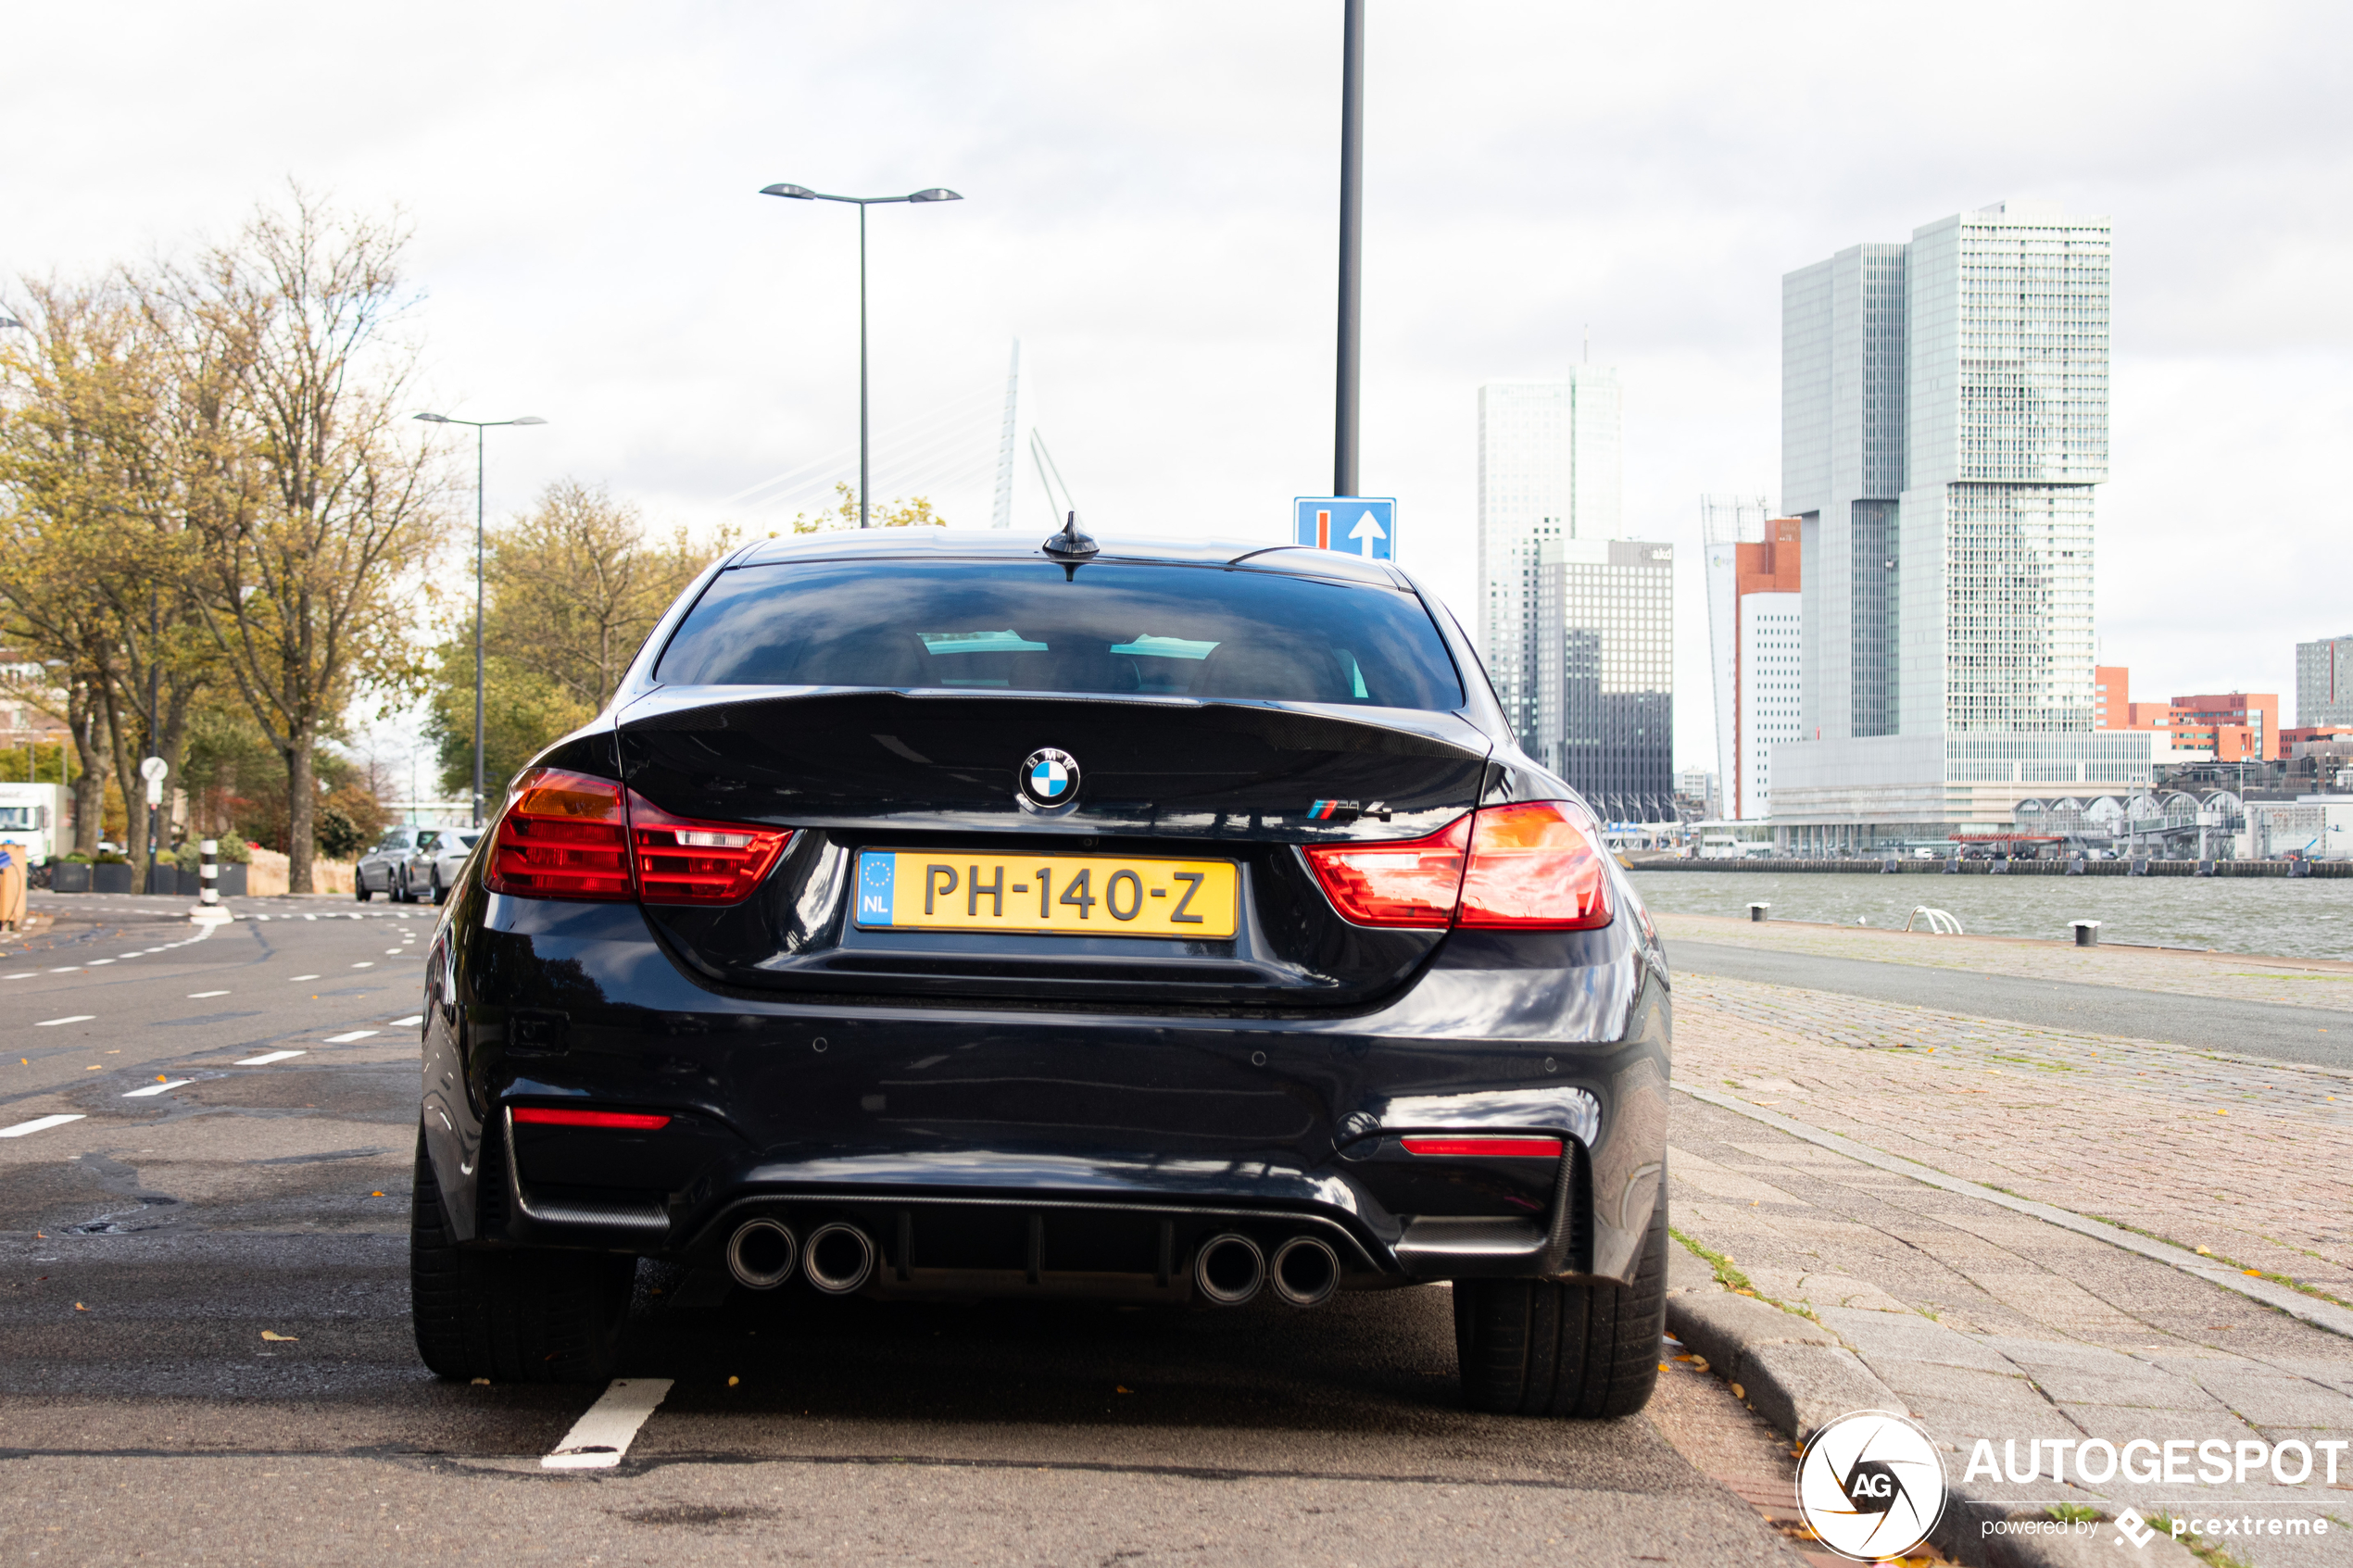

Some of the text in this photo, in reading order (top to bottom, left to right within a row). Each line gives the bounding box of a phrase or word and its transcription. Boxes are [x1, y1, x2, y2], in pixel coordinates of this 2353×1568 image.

[1652, 547, 1672, 560] akd
[1026, 750, 1076, 771] BMW
[925, 864, 1205, 923] PH-140-Z
[863, 896, 888, 913] NL
